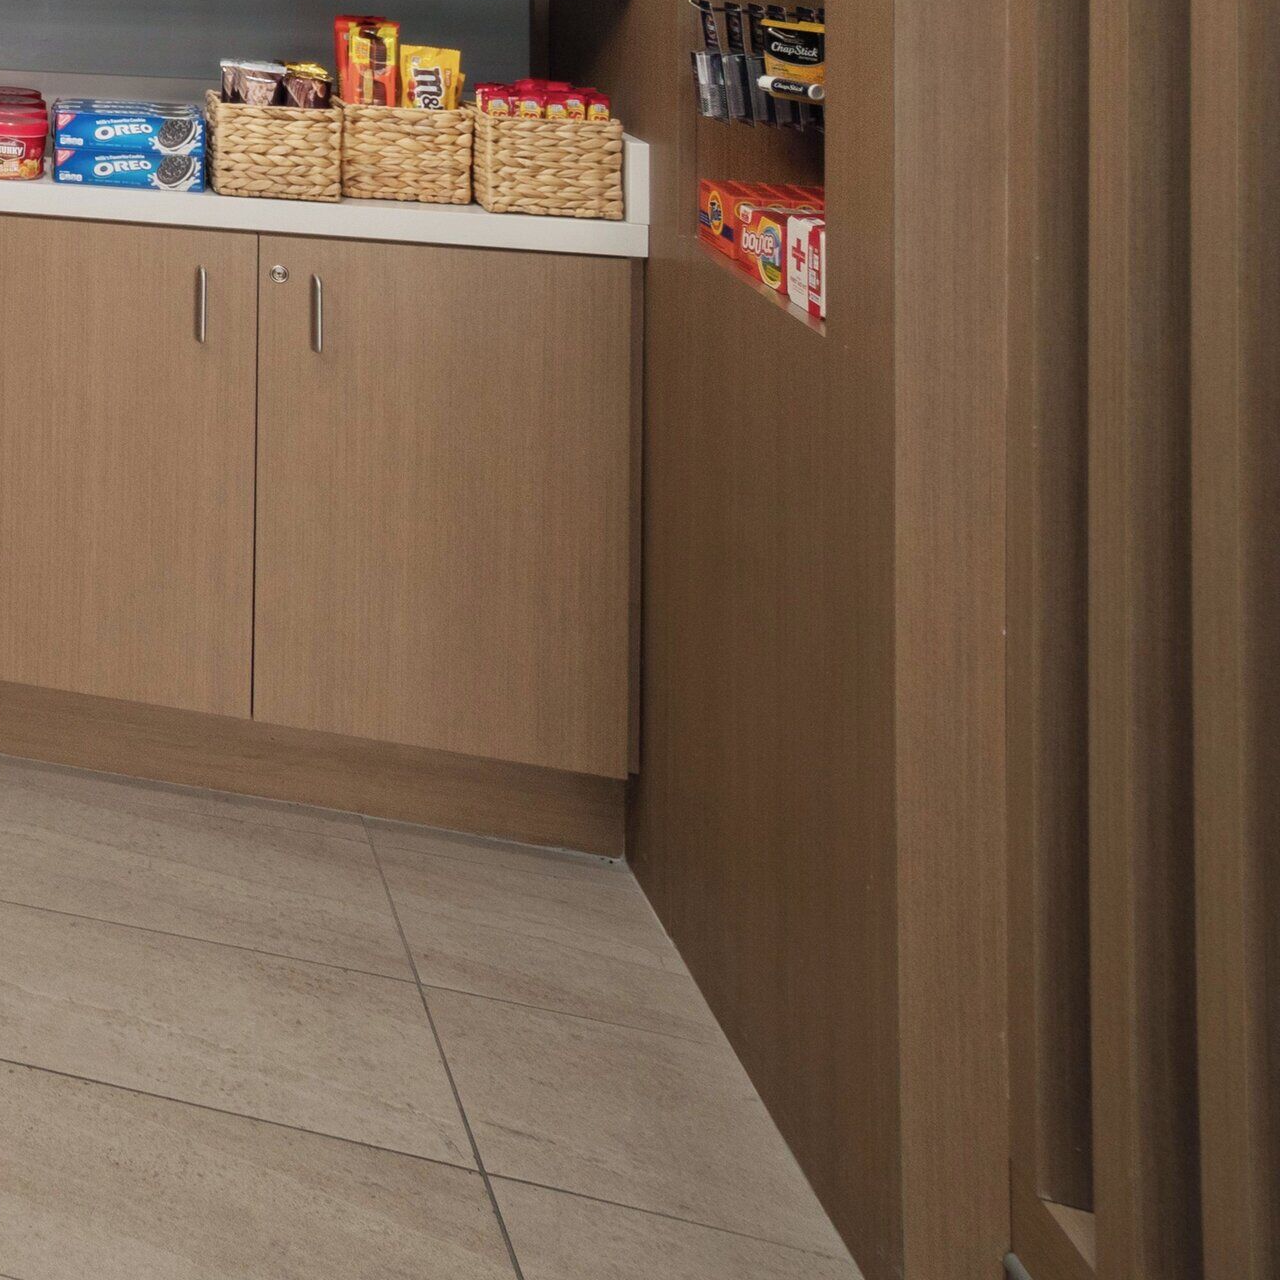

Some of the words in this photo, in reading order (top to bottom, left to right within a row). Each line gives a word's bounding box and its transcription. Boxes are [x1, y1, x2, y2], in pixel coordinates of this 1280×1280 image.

[771, 41, 818, 58] ChapStick
[94, 124, 153, 140] OREO
[93, 160, 152, 176] OREO
[742, 227, 775, 255] bounce
